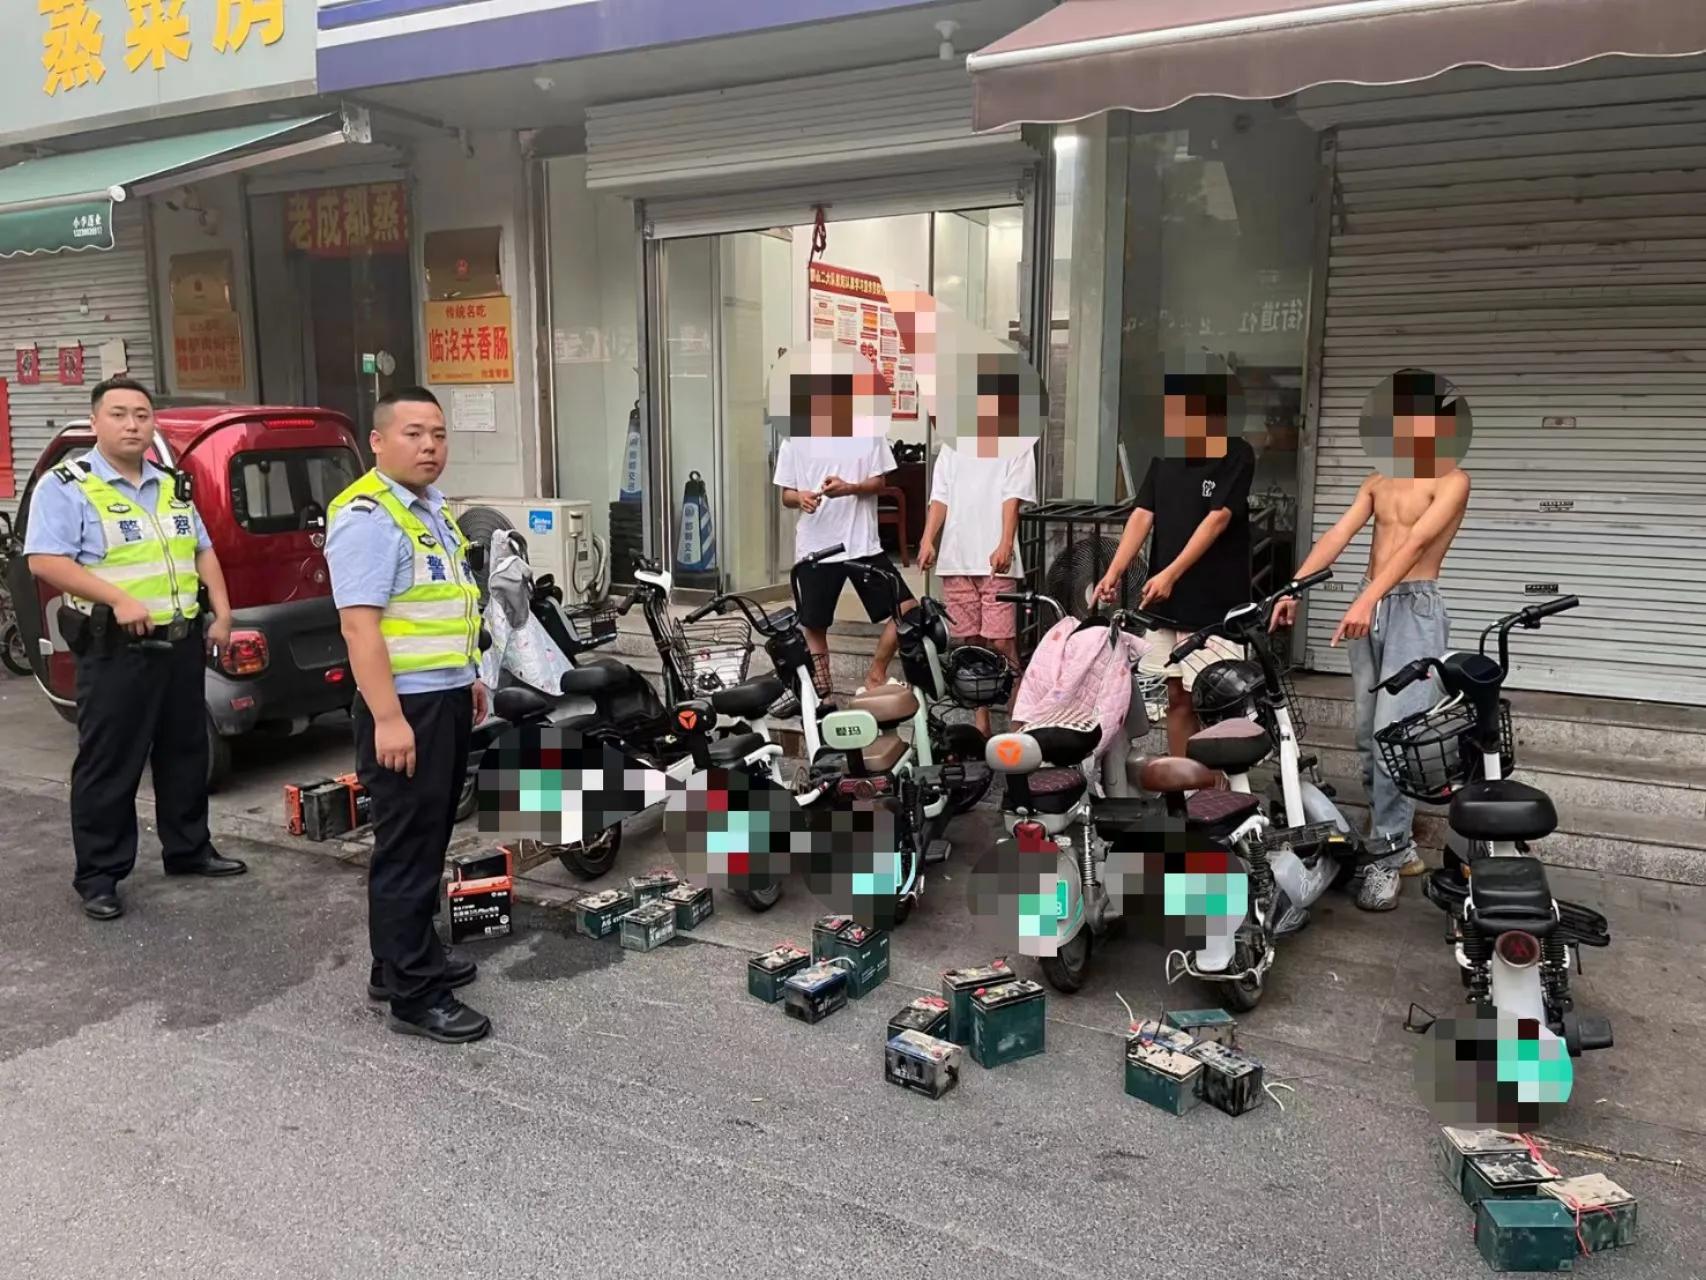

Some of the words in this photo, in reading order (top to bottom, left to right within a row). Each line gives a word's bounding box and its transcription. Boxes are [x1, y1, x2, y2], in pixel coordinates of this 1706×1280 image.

[287, 183, 407, 248] 老成都蒸
[446, 304, 486, 319] 传统名吃
[429, 326, 508, 362] 临洺关香肠
[118, 515, 192, 543] 警察
